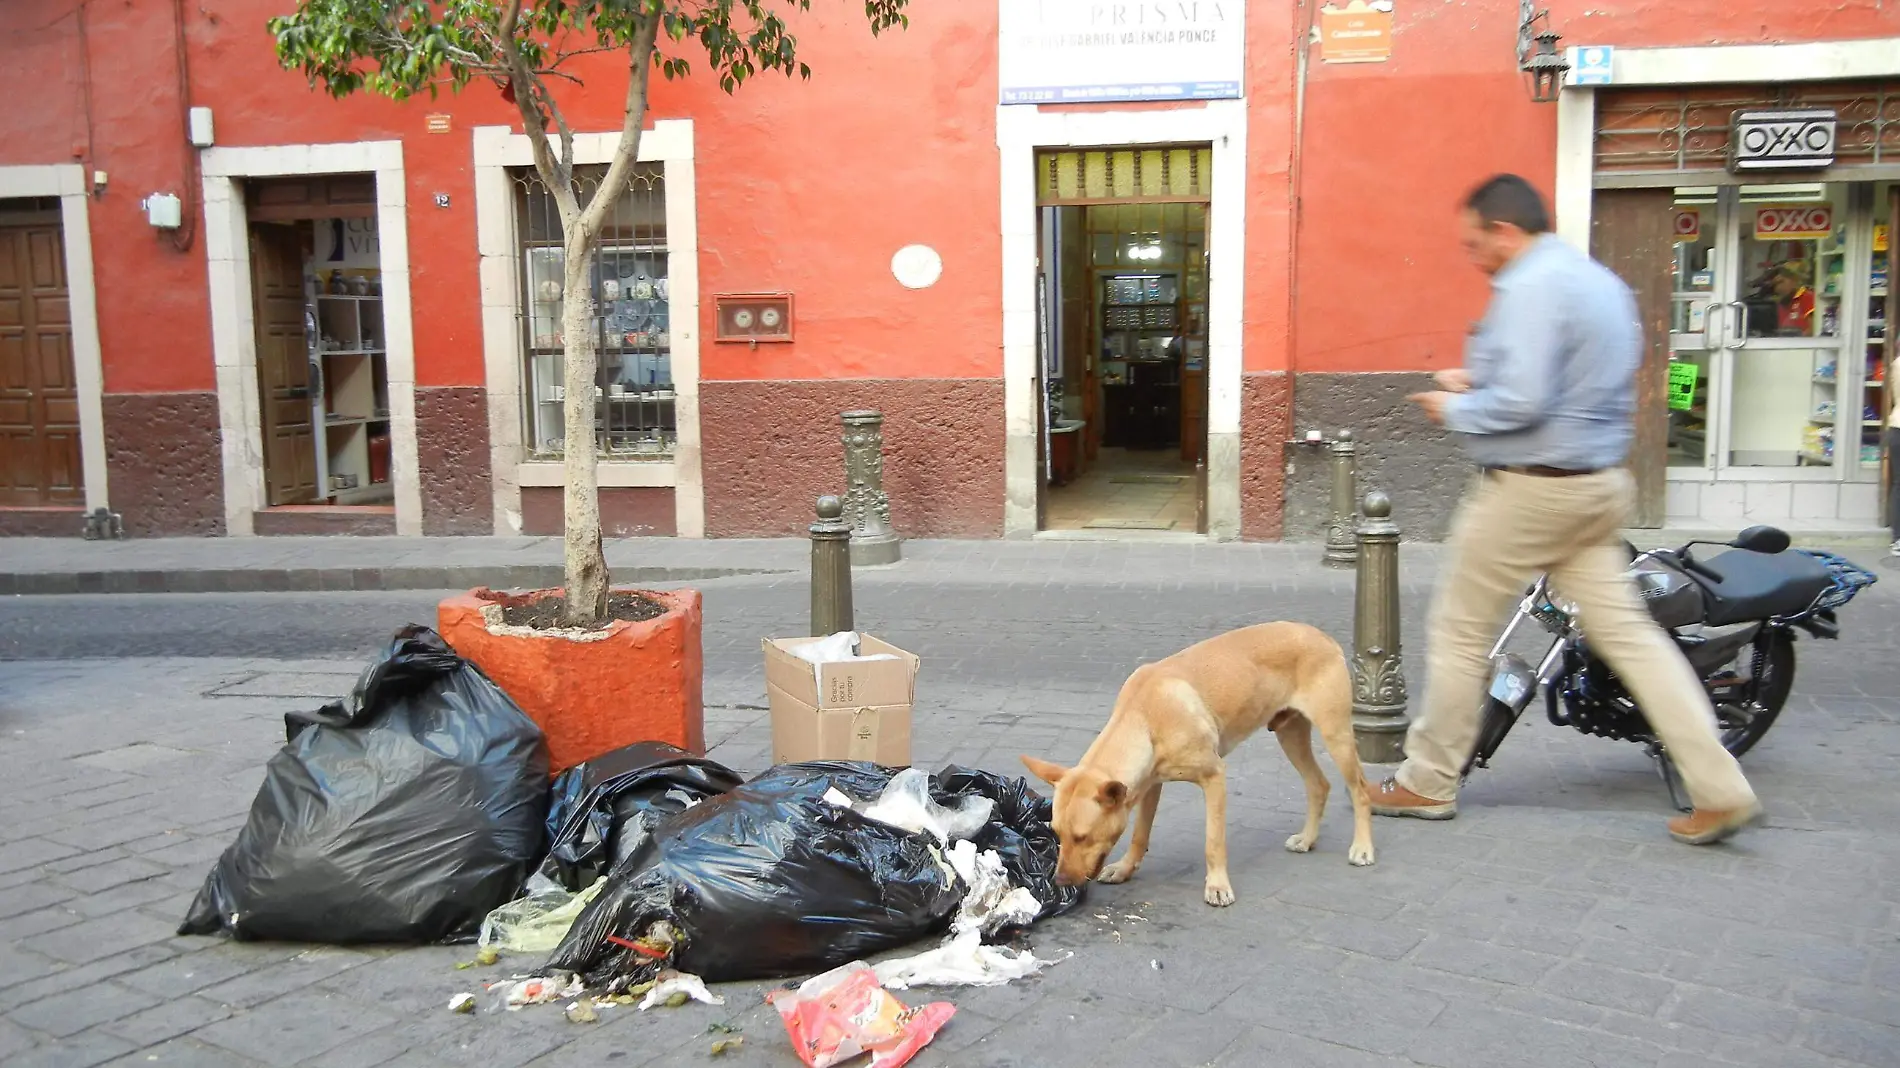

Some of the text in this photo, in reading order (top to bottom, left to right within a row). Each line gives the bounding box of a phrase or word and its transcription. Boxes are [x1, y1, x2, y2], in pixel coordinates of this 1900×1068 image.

[1090, 1, 1225, 26] PRISMA
[1068, 32, 1116, 47] GABRIEL
[1120, 30, 1175, 45] VALENCIA
[1178, 29, 1217, 44] PONCE
[1744, 122, 1830, 156] OXXO
[1759, 209, 1830, 232] OXXO
